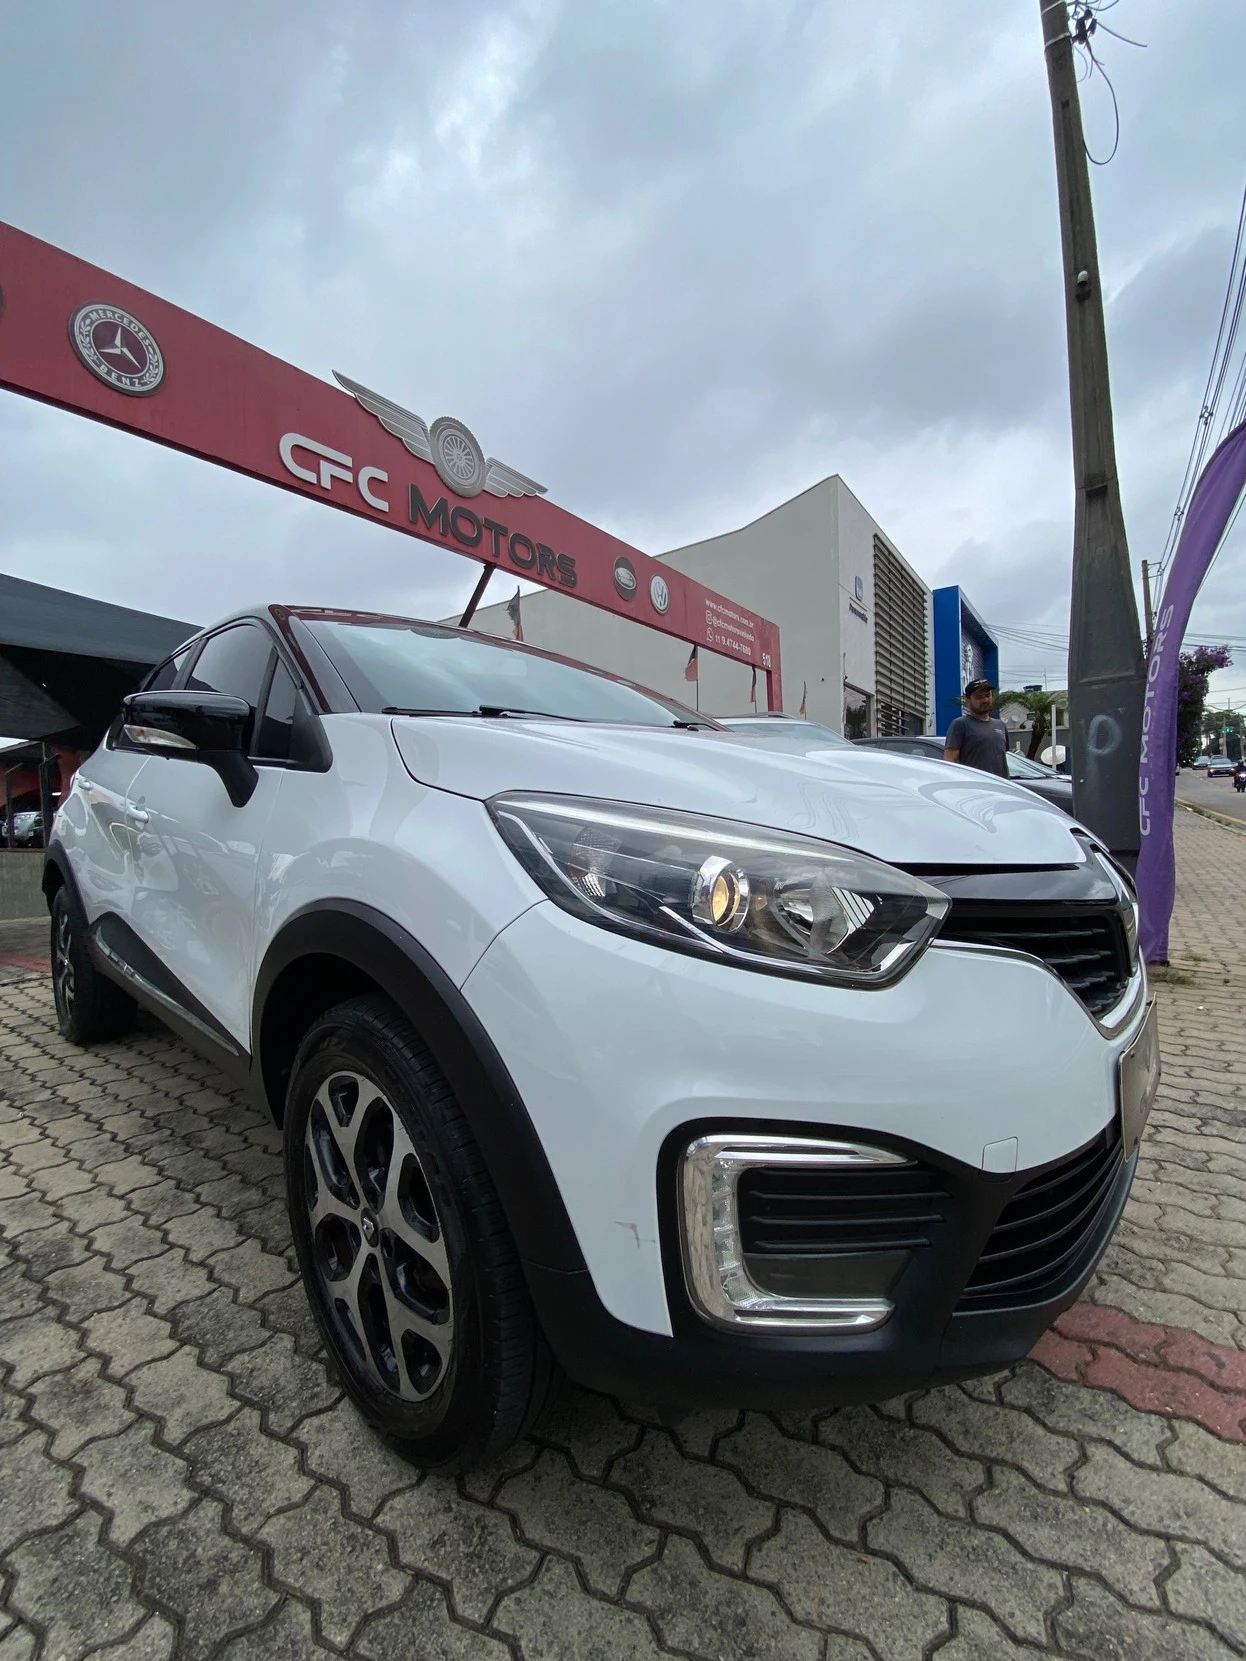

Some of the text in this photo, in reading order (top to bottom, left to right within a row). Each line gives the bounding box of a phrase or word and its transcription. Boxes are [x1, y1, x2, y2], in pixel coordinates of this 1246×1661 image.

[89, 309, 152, 347] MERCEDES
[99, 363, 142, 387] BENZ
[279, 432, 578, 588] CFC MOTORS
[705, 599, 755, 628] www.cfcmotors.com.br
[1139, 603, 1175, 836] CFC MOTORS
